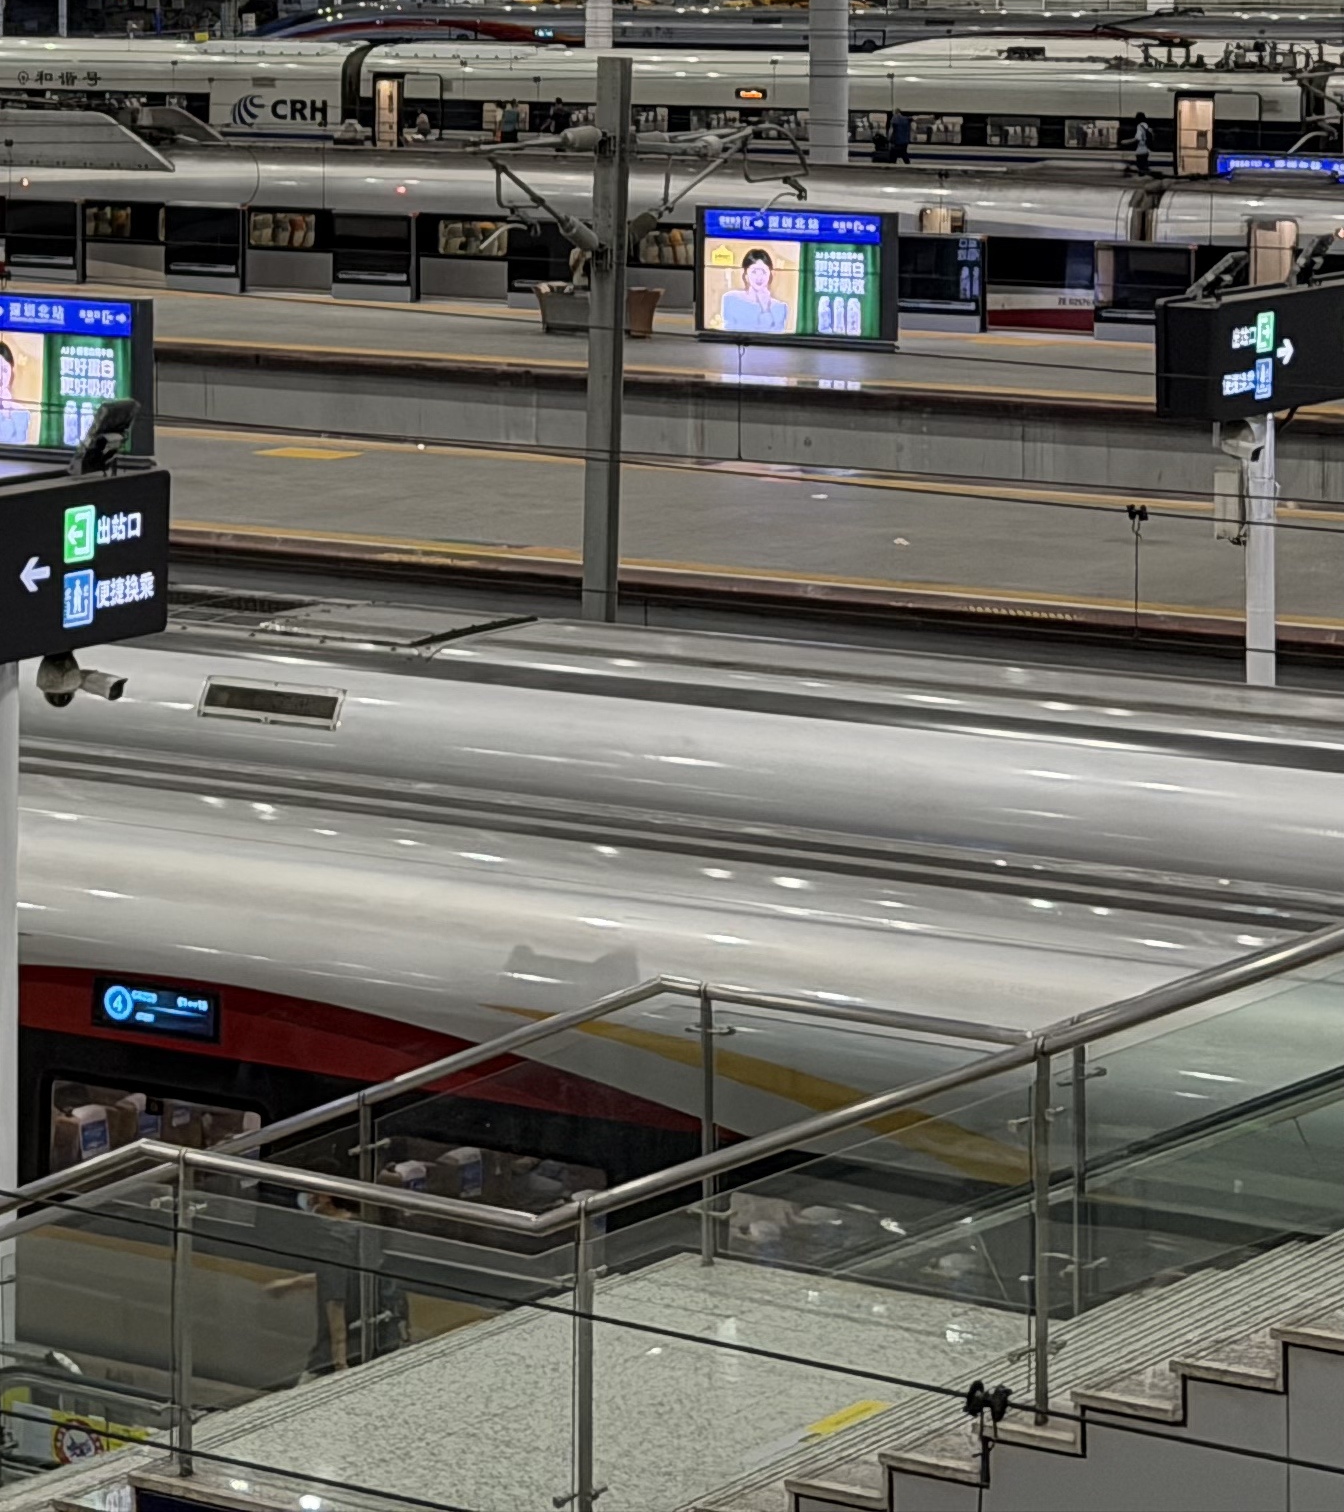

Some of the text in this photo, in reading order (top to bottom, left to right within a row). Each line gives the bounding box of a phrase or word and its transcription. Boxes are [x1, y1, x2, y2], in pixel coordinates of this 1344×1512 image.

[271, 99, 328, 126] CRH
[97, 512, 142, 544] 出站口
[95, 571, 155, 609] 便捷换乘
